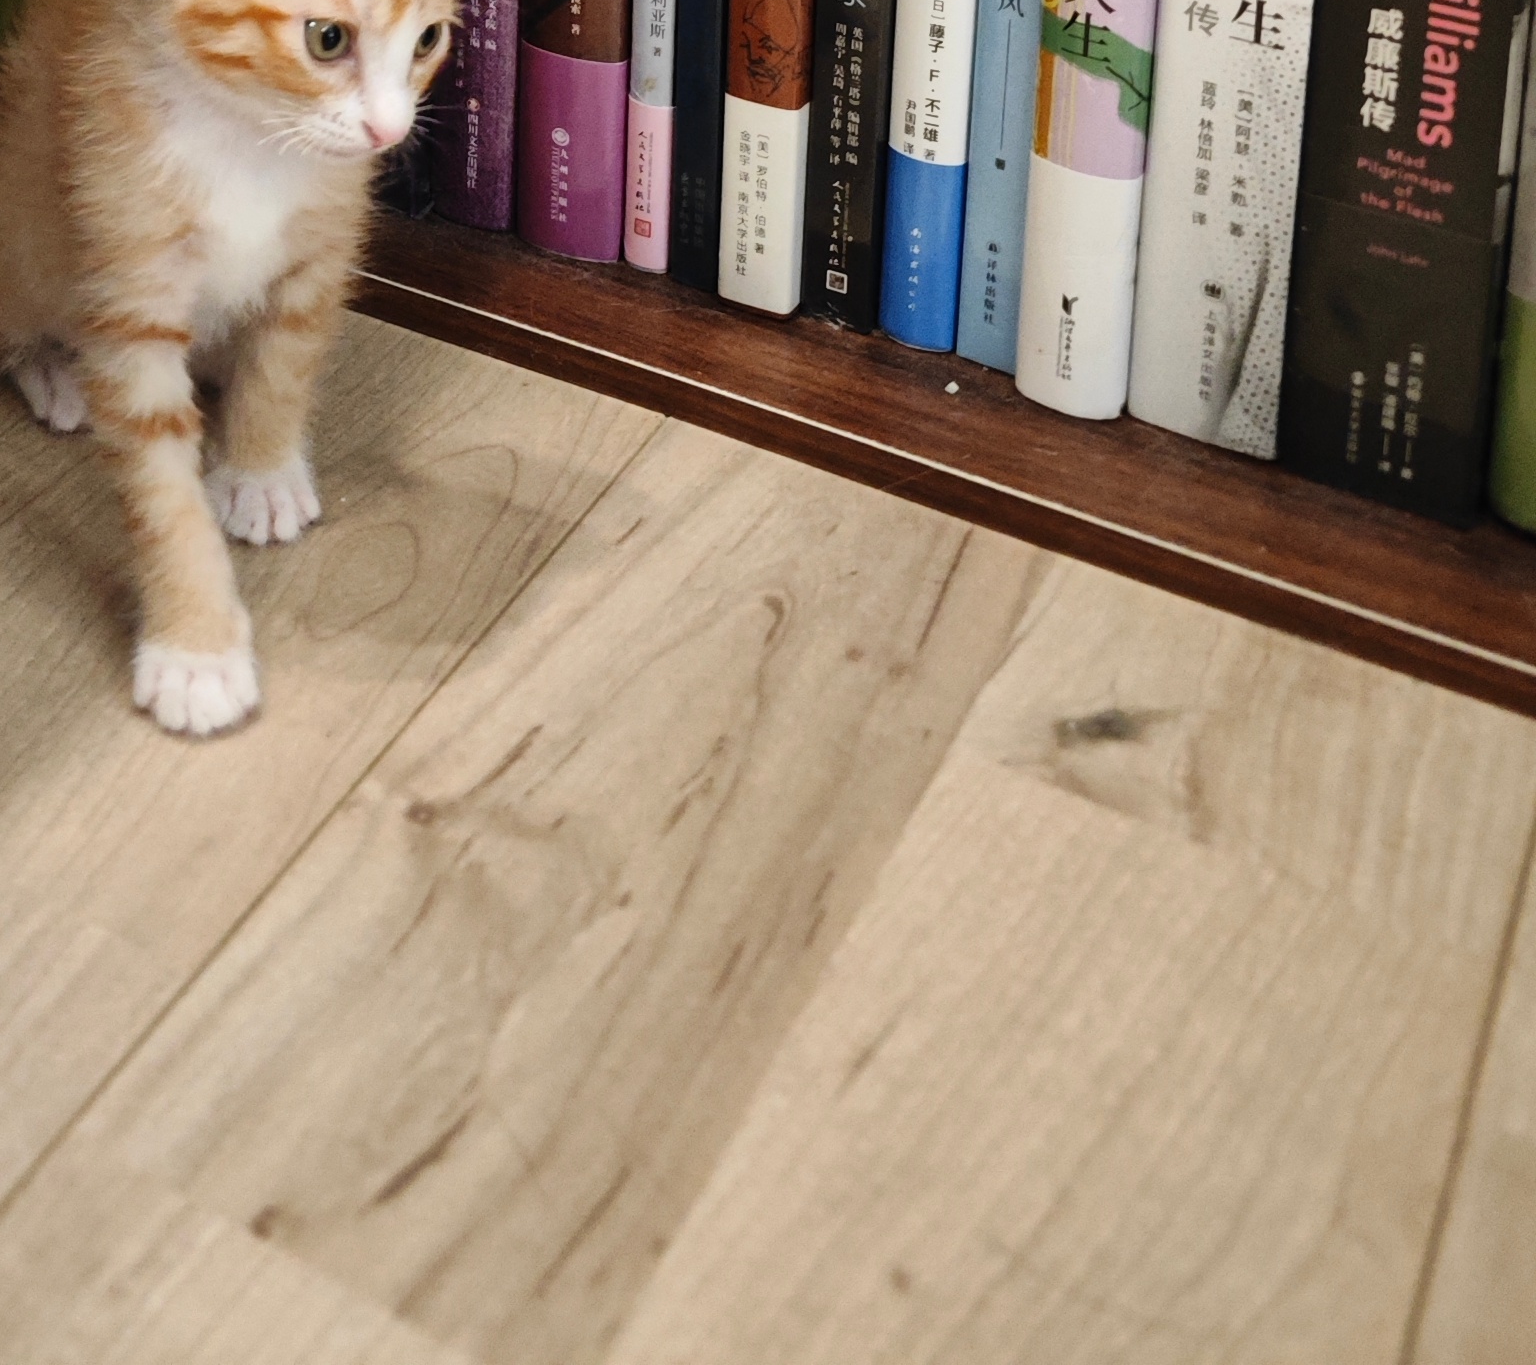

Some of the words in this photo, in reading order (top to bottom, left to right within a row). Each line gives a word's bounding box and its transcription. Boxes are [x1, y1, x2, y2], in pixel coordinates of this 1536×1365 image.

[735, 191, 750, 277] 南京大学出版社
